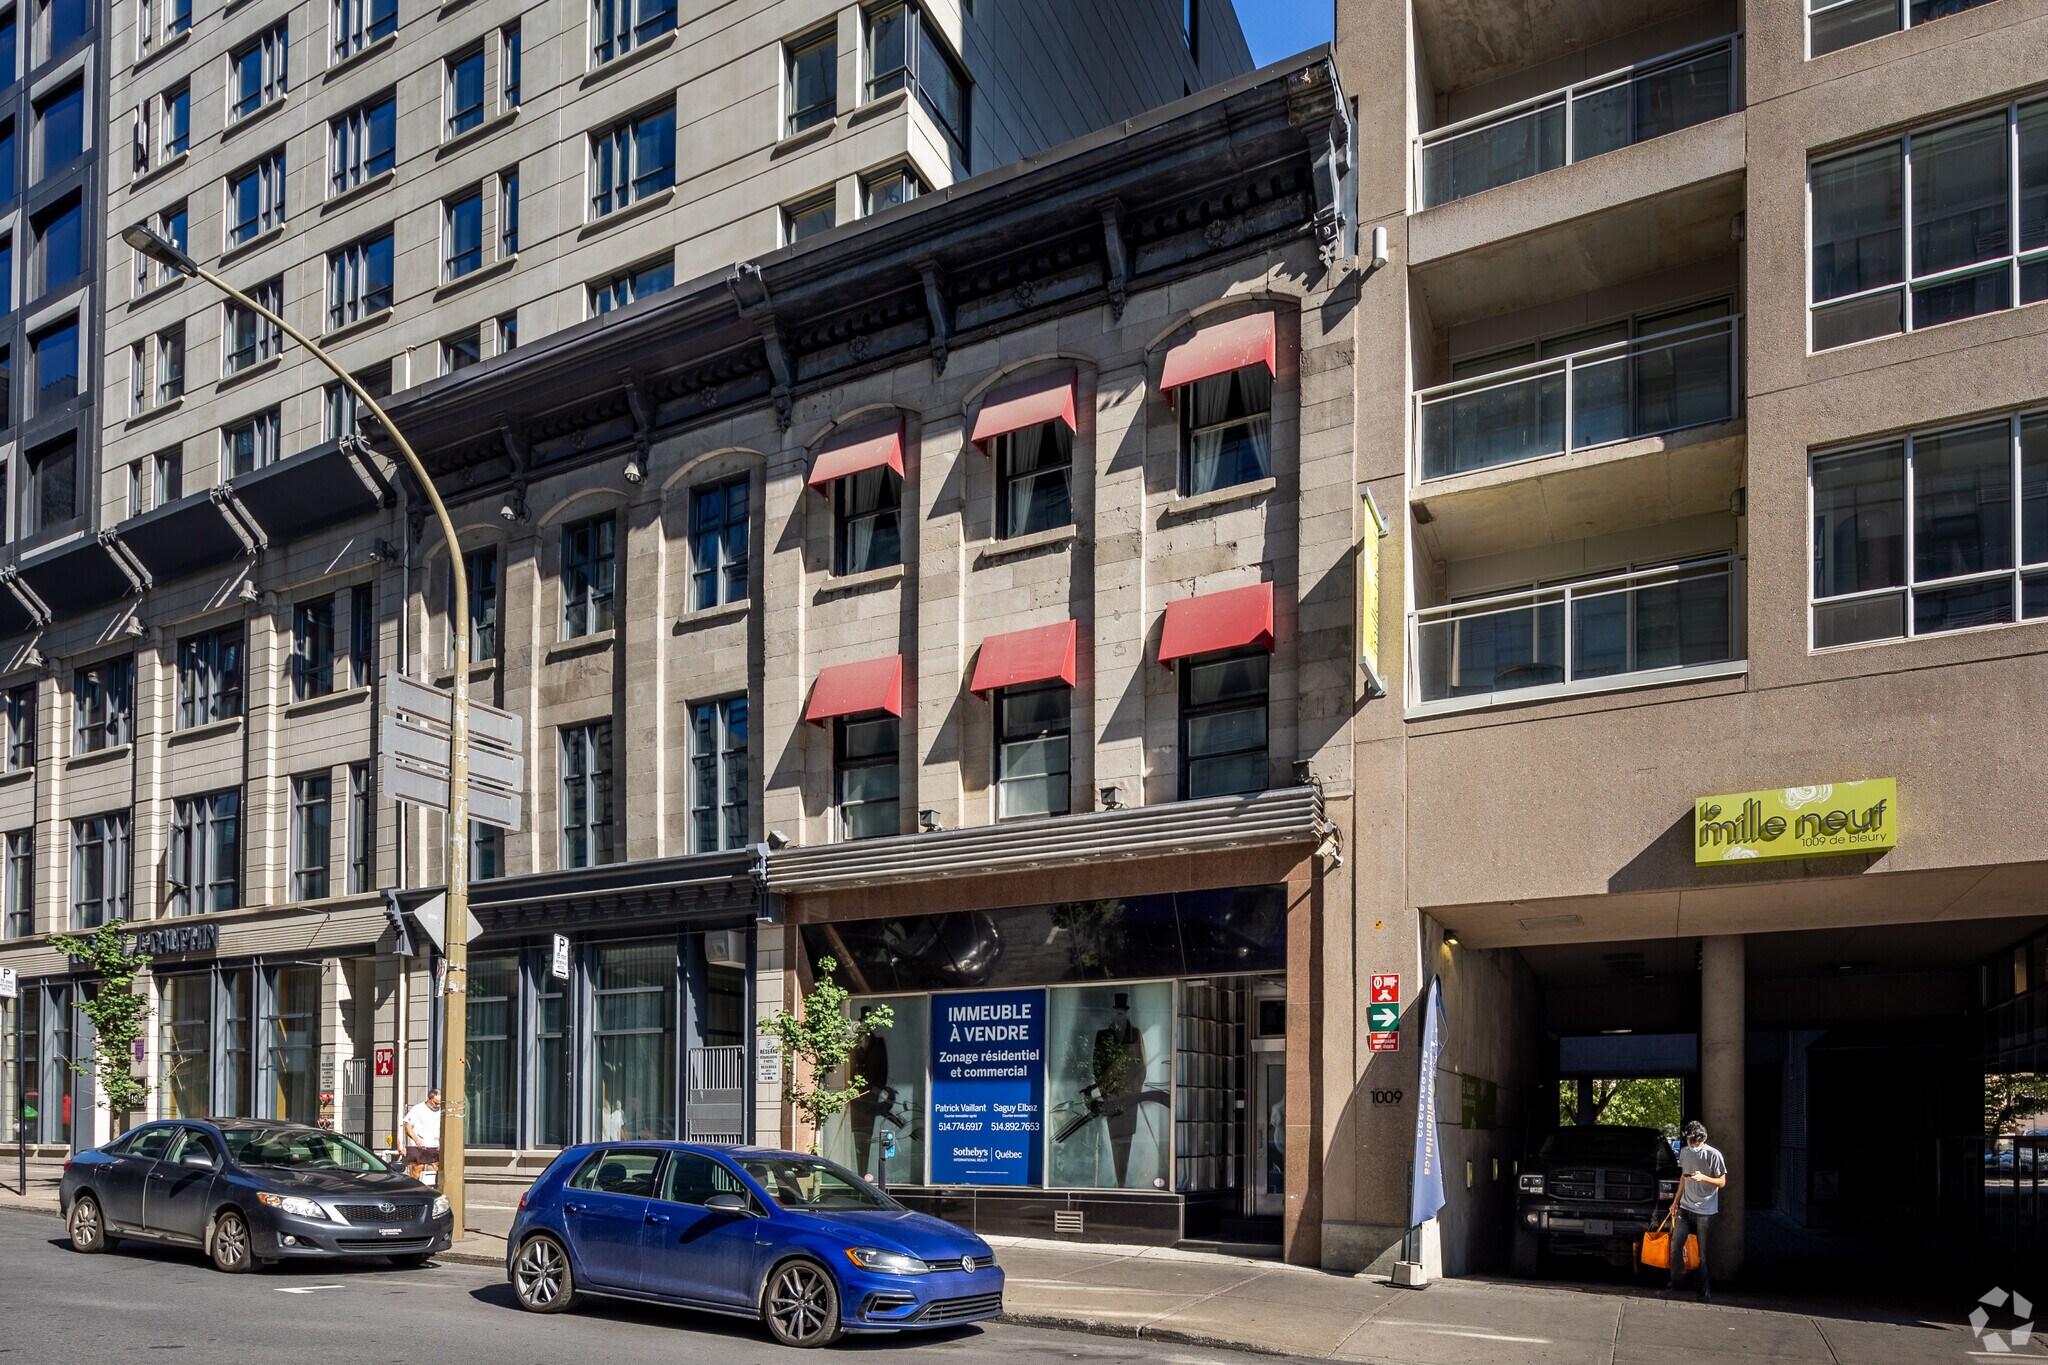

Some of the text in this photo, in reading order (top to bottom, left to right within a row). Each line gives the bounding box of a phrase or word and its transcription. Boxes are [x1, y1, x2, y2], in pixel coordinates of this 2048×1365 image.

[1700, 802, 1721, 822] le
[1700, 798, 1887, 847] mille neuf
[1801, 832, 1887, 847] 1009 de bleury
[150, 923, 219, 955] DAUPHIN
[559, 938, 565, 952] P
[4, 969, 10, 978] P
[948, 1003, 1032, 1022] IMMEUBLE
[949, 1024, 1029, 1042] À VENDRE
[939, 1049, 1039, 1065] Zonage résidentiel
[950, 1065, 1027, 1078] et commercial
[1370, 1090, 1403, 1104] 1009
[935, 1103, 987, 1112] Patrick Vaillant
[993, 1103, 1038, 1113] Saguy Elbaz
[938, 1122, 983, 1131] 514.774.6917
[991, 1122, 1040, 1131] 514.892.7653
[953, 1147, 989, 1158] Sotheby's
[994, 1149, 1023, 1160] Québec
